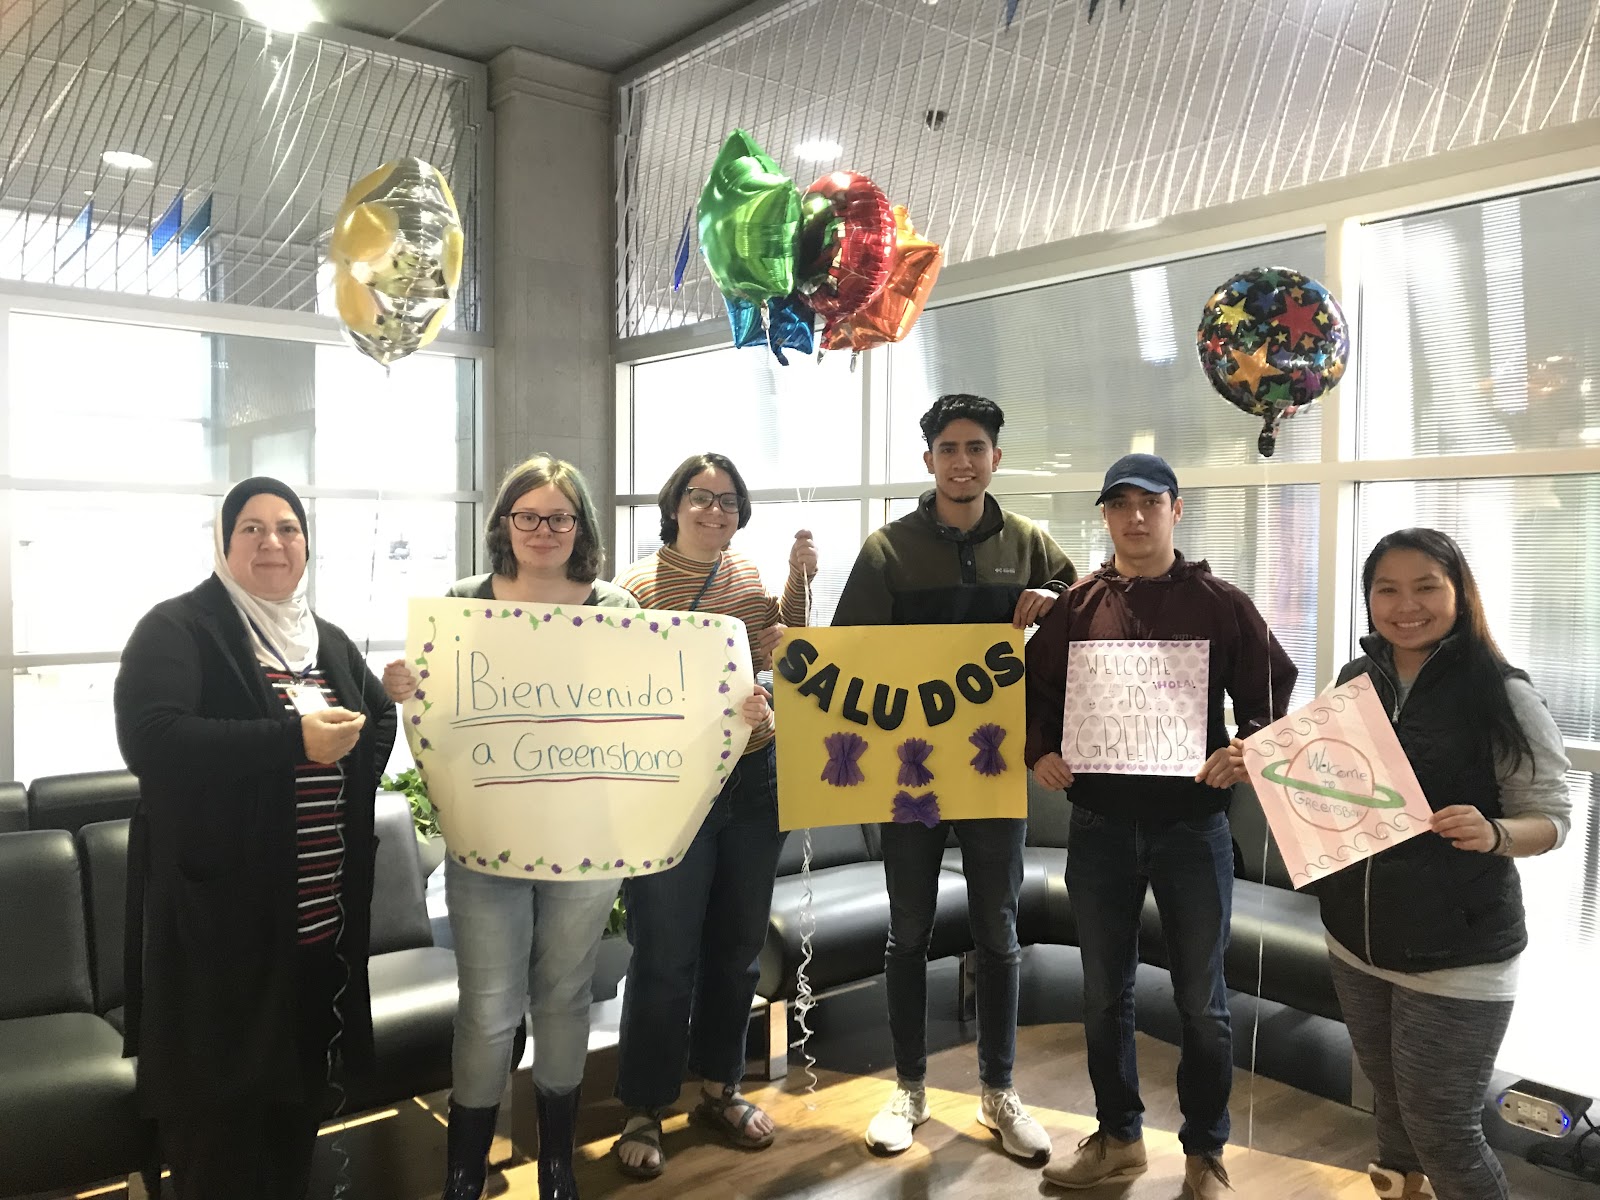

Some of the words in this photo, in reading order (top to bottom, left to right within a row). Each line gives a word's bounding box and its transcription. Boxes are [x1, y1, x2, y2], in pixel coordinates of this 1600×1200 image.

[454, 635, 686, 716] ¡Bienvenido!
[1085, 654, 1171, 676] WELCOME
[777, 639, 1025, 731] SALUDOS
[1125, 685, 1147, 710] TO
[472, 742, 496, 765] a
[513, 732, 683, 772] Greensboro
[1322, 779, 1336, 789] to
